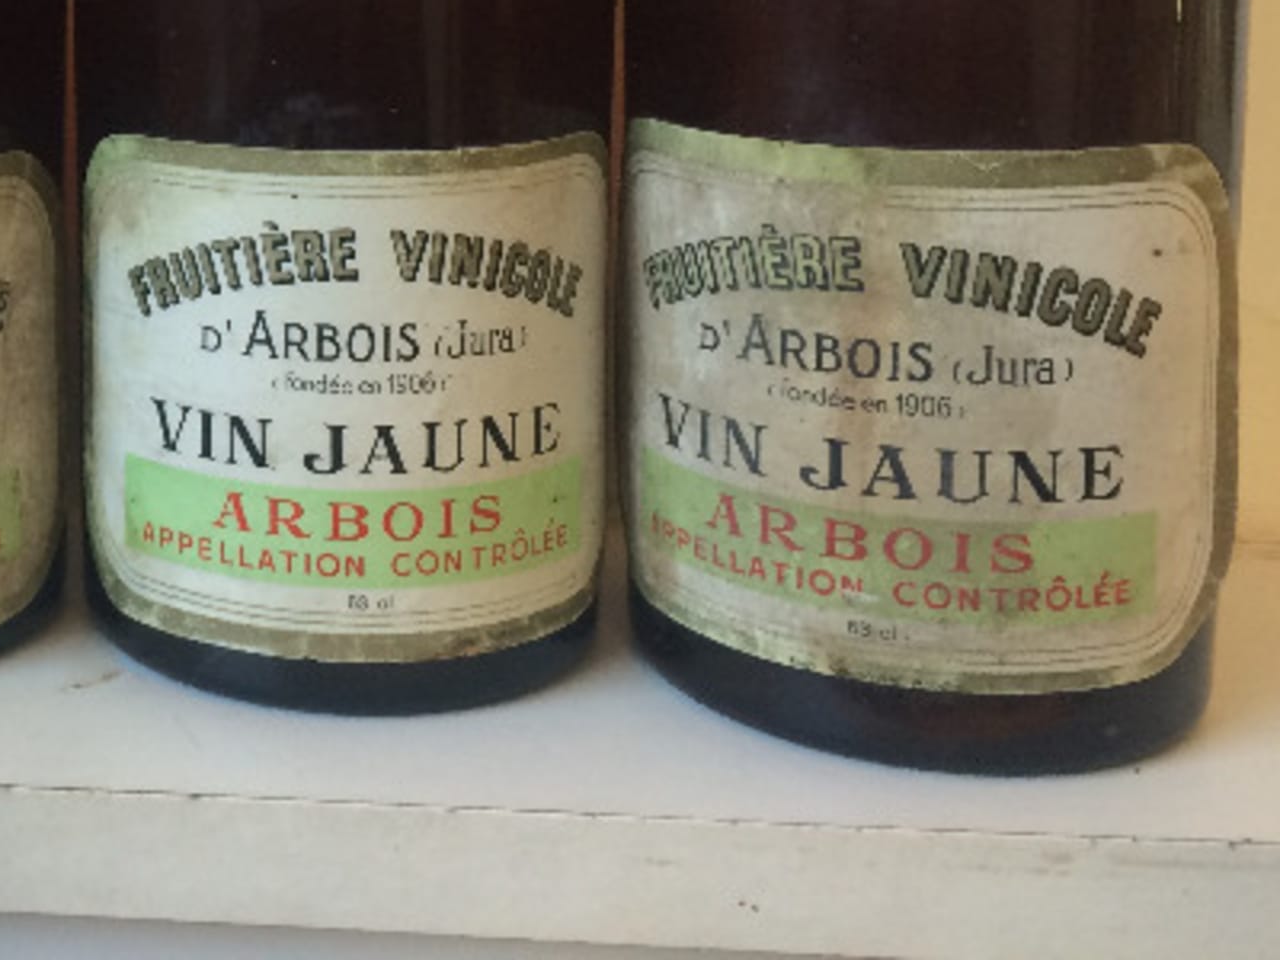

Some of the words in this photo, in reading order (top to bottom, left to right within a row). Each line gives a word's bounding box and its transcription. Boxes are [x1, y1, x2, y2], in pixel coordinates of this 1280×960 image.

[128, 221, 359, 316] FRUITIÈRE
[390, 229, 583, 318] VINICOLE
[643, 224, 865, 310] FRUITIÈRE
[899, 242, 1162, 358] VINICOLE
[953, 345, 1074, 386] (Jura)
[152, 396, 274, 470] VIN
[304, 403, 561, 475] JAUNE
[658, 393, 768, 478] VIN
[799, 437, 1125, 504] JAUNE
[143, 521, 366, 578] APPELLATION
[391, 515, 569, 577] CONTRÔLÉE
[214, 492, 502, 541] ARBOIS
[706, 493, 1036, 575] ARBOIS
[650, 510, 864, 596] APPELLATION
[893, 571, 1132, 613] CONTRÔLÉE
